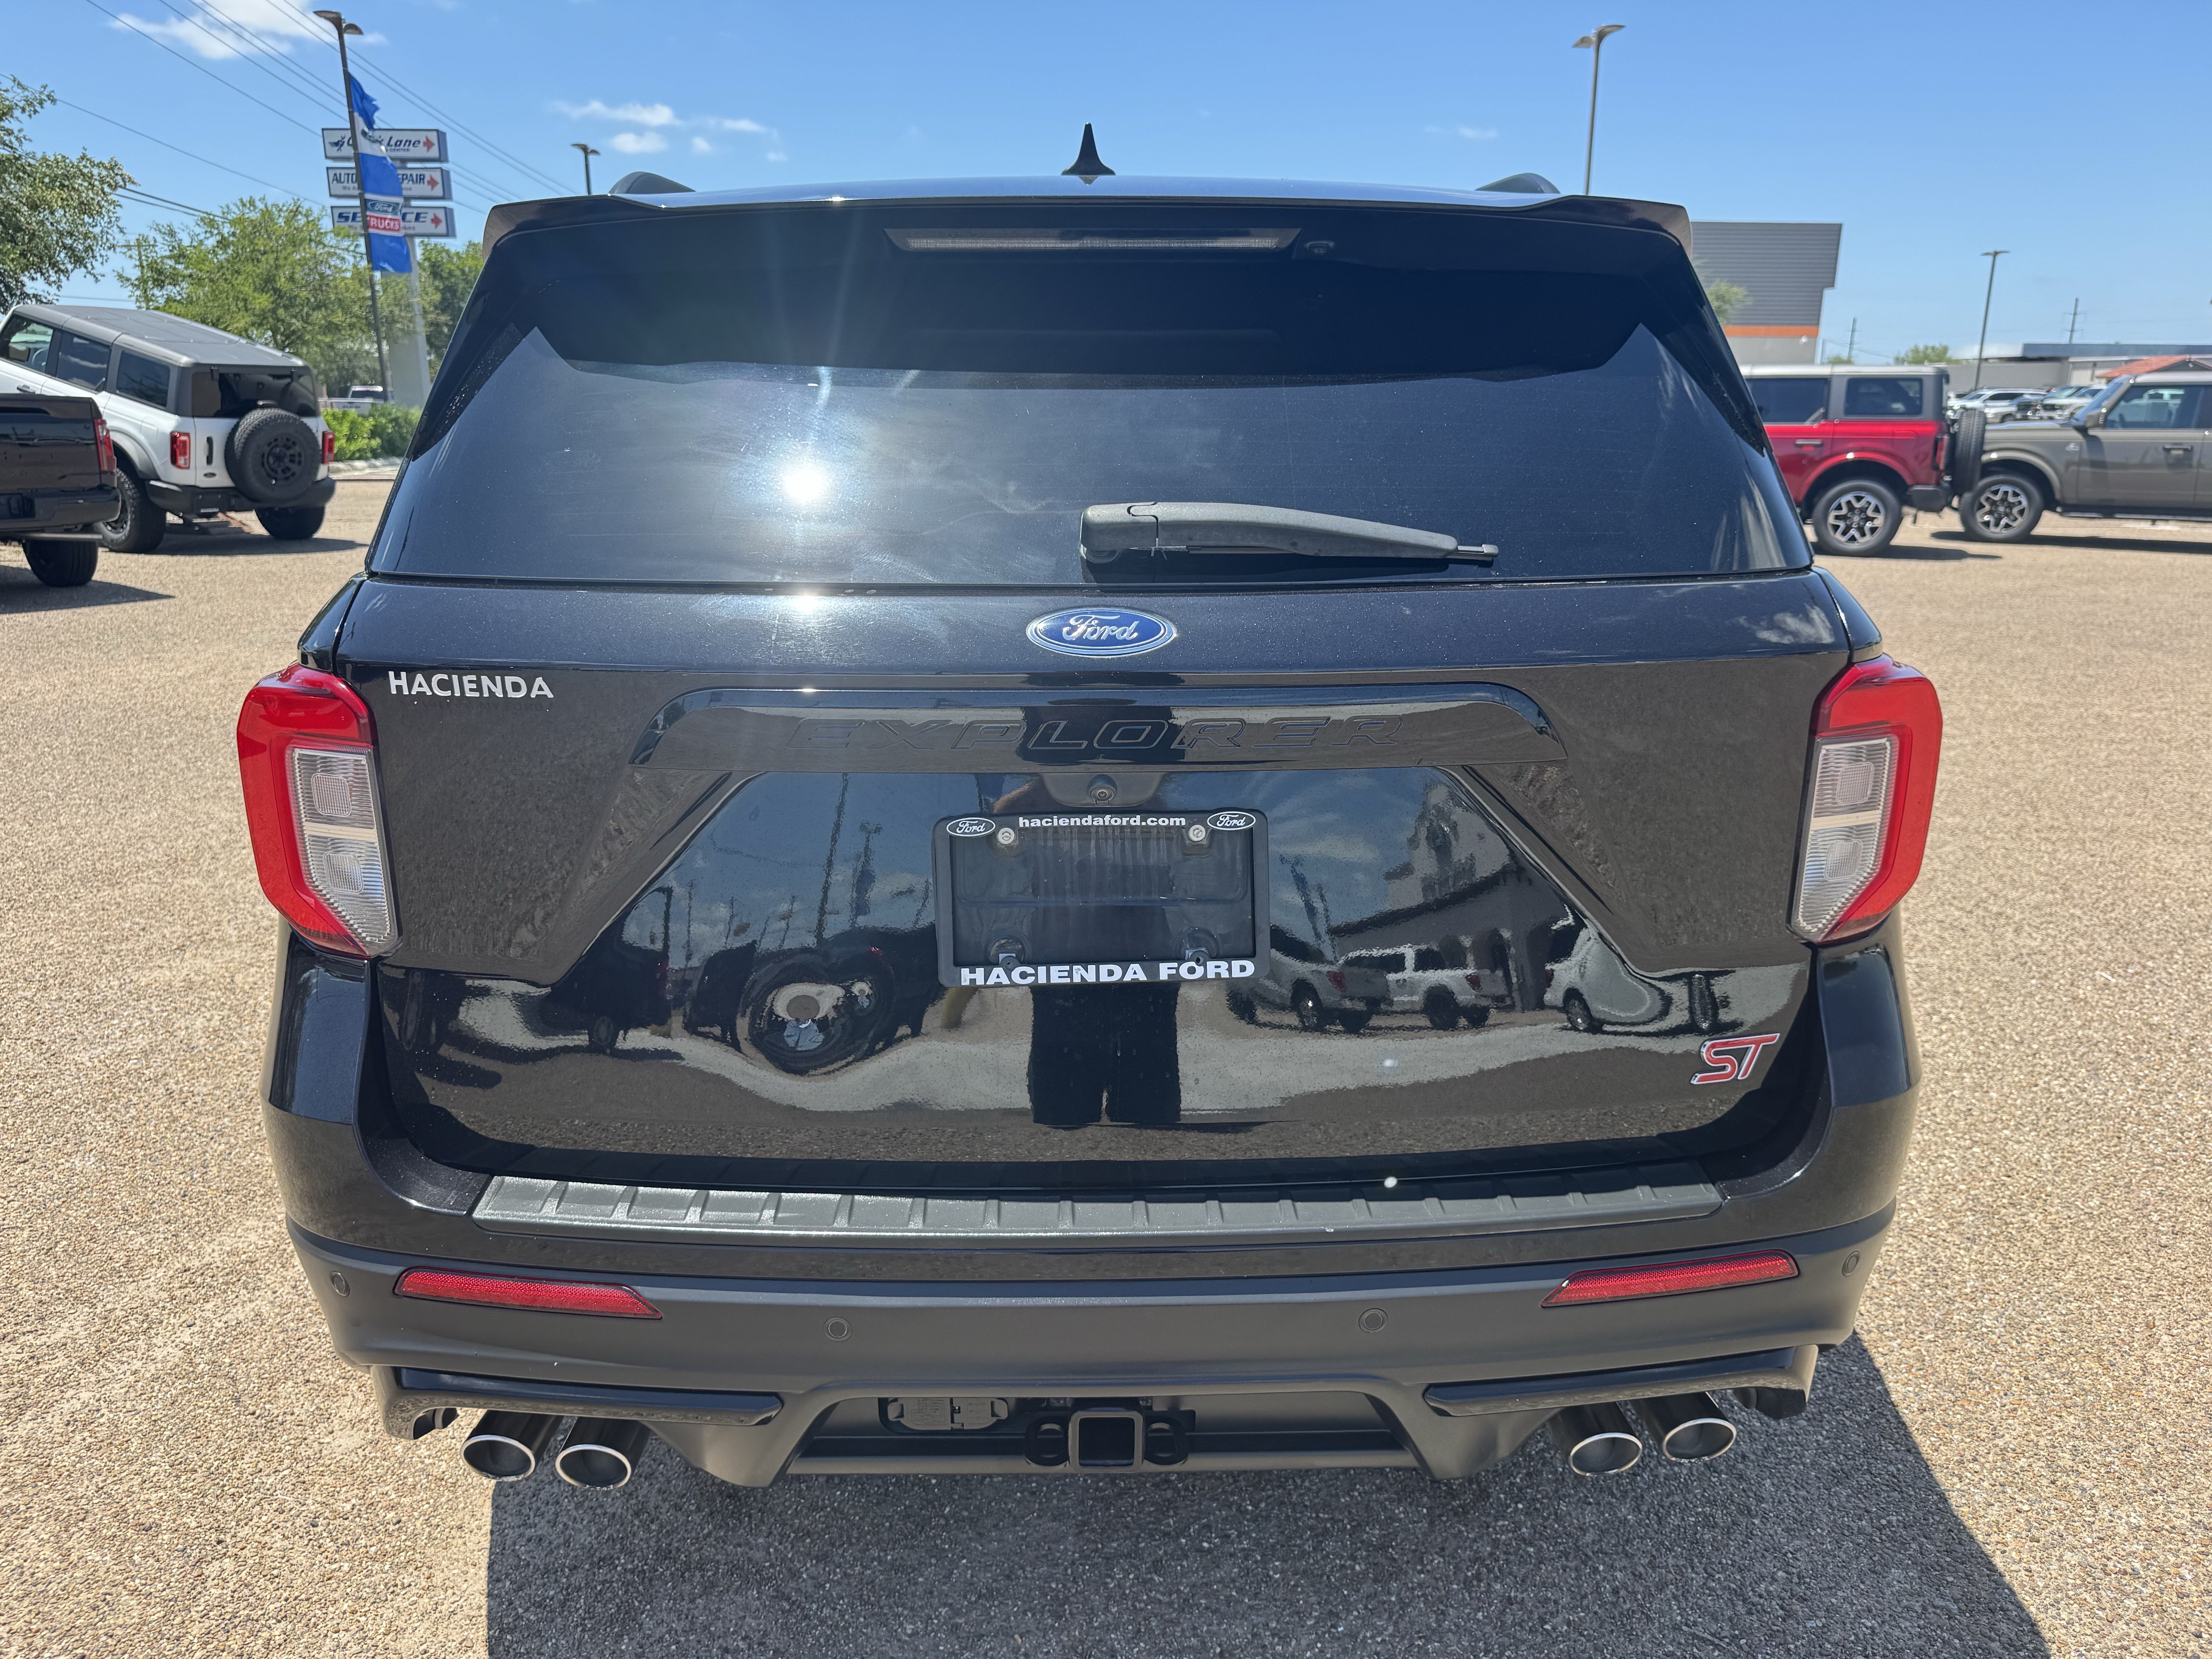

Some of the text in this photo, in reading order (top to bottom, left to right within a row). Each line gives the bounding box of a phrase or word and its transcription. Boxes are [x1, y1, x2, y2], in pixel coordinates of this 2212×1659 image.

[387, 136, 421, 148] Lane
[374, 203, 393, 213] Ford
[1062, 615, 1140, 641] Ford
[388, 671, 554, 698] HACIENDA
[785, 715, 1403, 749] EXPLORER
[956, 820, 986, 833] Ford
[1018, 814, 1186, 828] haciendaford.com
[1216, 814, 1246, 827] Ford
[960, 960, 1255, 986] HACIENDA FORD
[1690, 1033, 1780, 1084] ST
